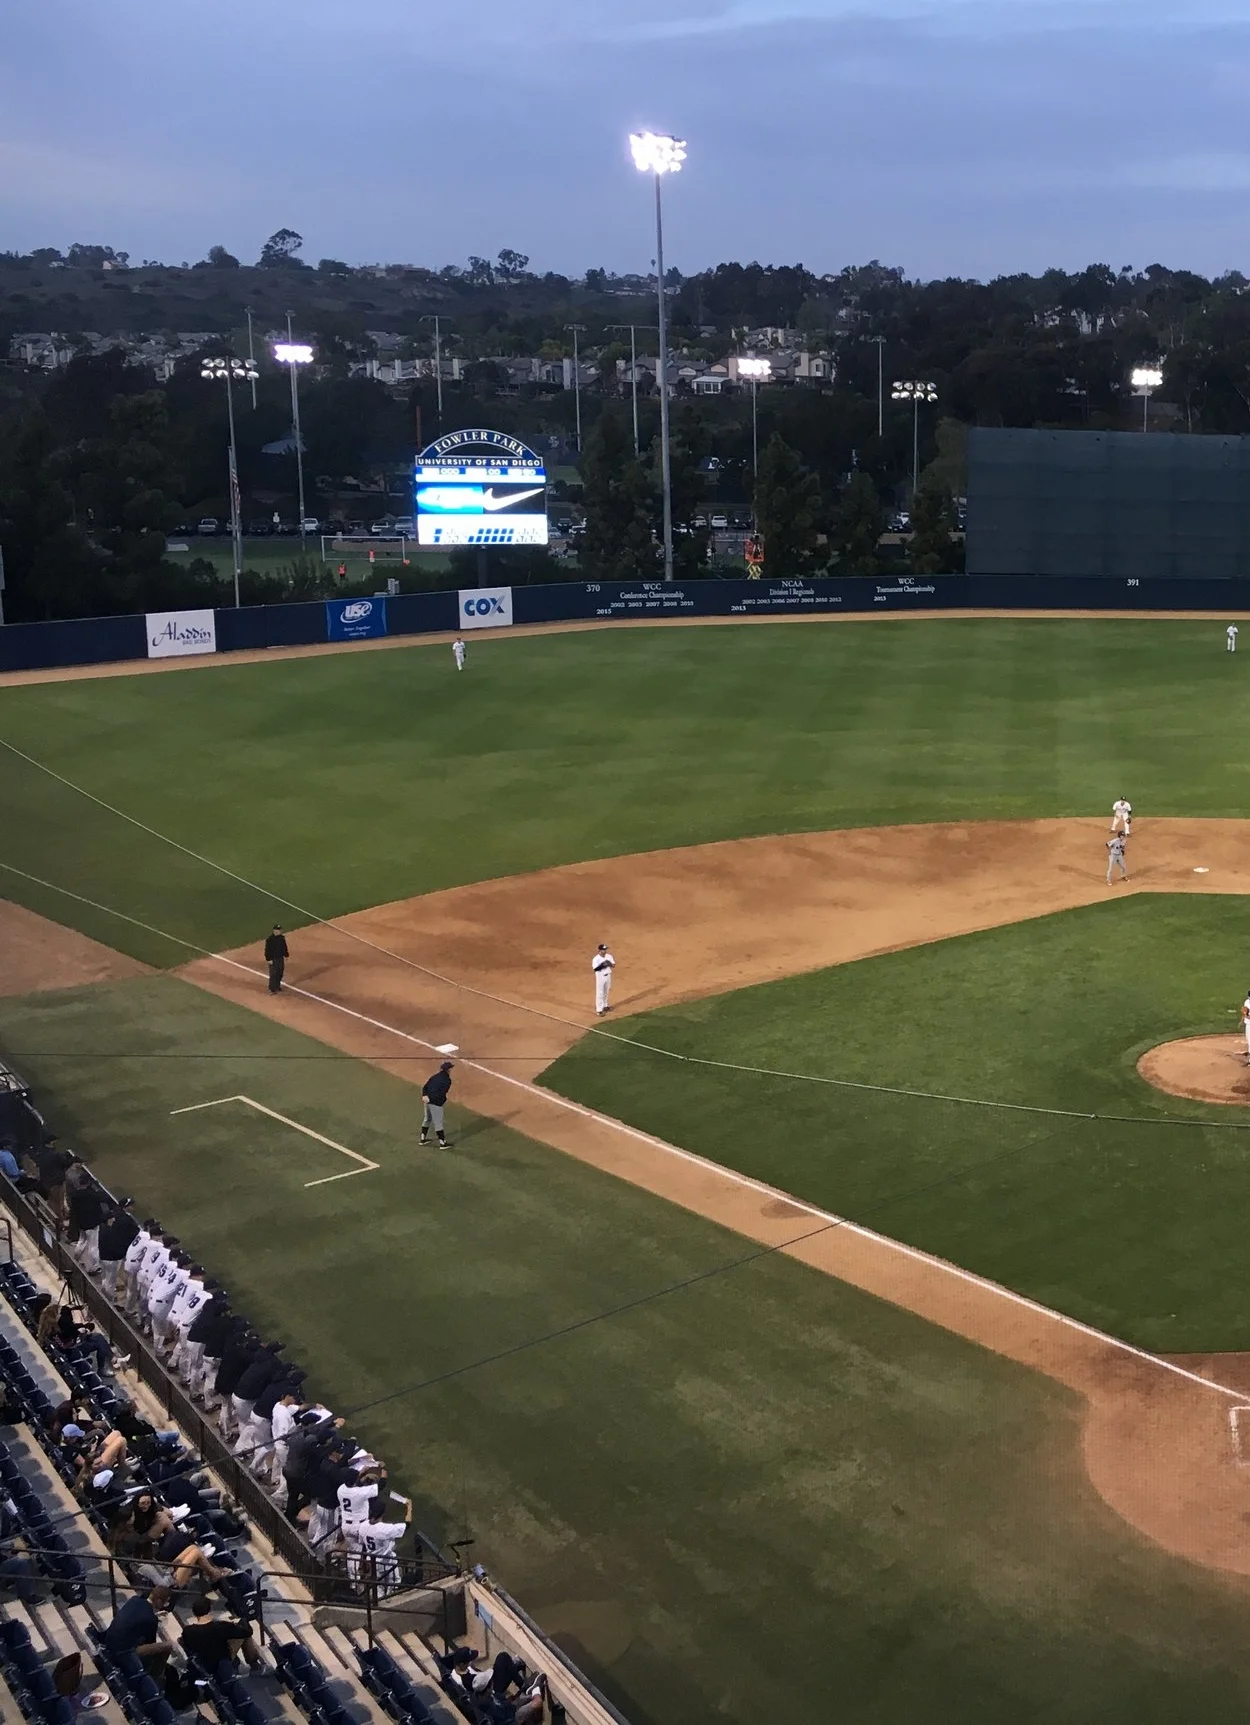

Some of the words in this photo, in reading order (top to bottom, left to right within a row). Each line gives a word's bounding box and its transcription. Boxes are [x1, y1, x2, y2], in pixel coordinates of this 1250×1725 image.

[433, 431, 489, 453] FOWLER
[493, 434, 527, 457] PARK
[643, 583, 662, 591] WCC
[781, 580, 804, 588] NCAA
[897, 577, 915, 585] WCC
[1126, 578, 1139, 586] 391
[586, 584, 601, 592] 370
[464, 595, 506, 617] COX
[152, 620, 212, 647] Aladdin
[342, 1497, 353, 1513] 2
[365, 1535, 377, 1551] 5
